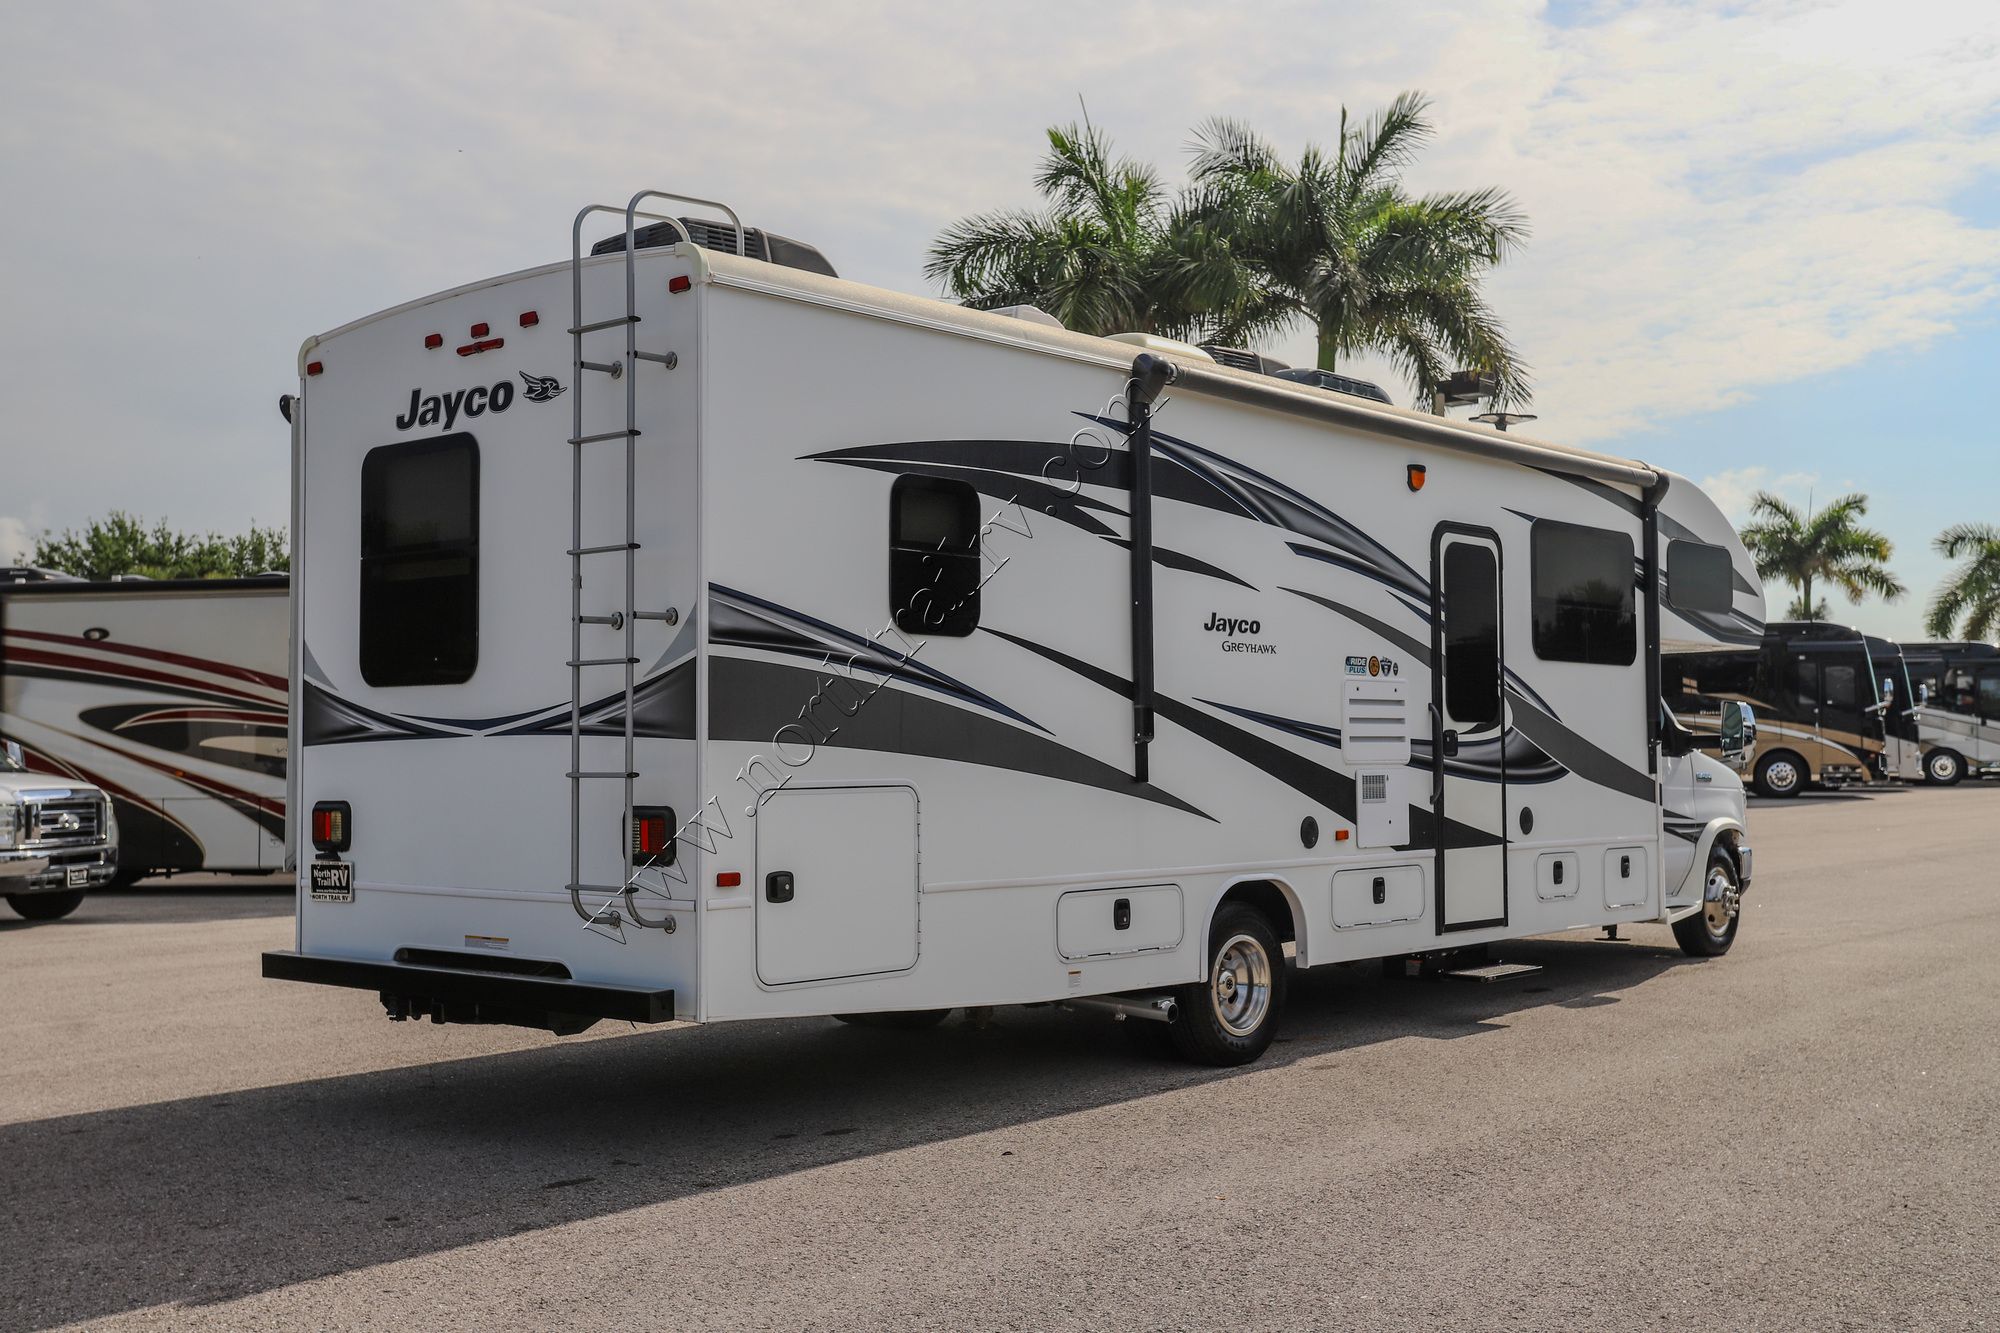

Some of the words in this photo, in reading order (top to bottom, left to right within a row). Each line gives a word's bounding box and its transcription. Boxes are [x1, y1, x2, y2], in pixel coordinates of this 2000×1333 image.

[396, 380, 514, 432] Jayco
[1203, 611, 1261, 637] Jayco
[1348, 666, 1366, 674] PLUS
[313, 869, 330, 878] North
[330, 869, 348, 887] RV
